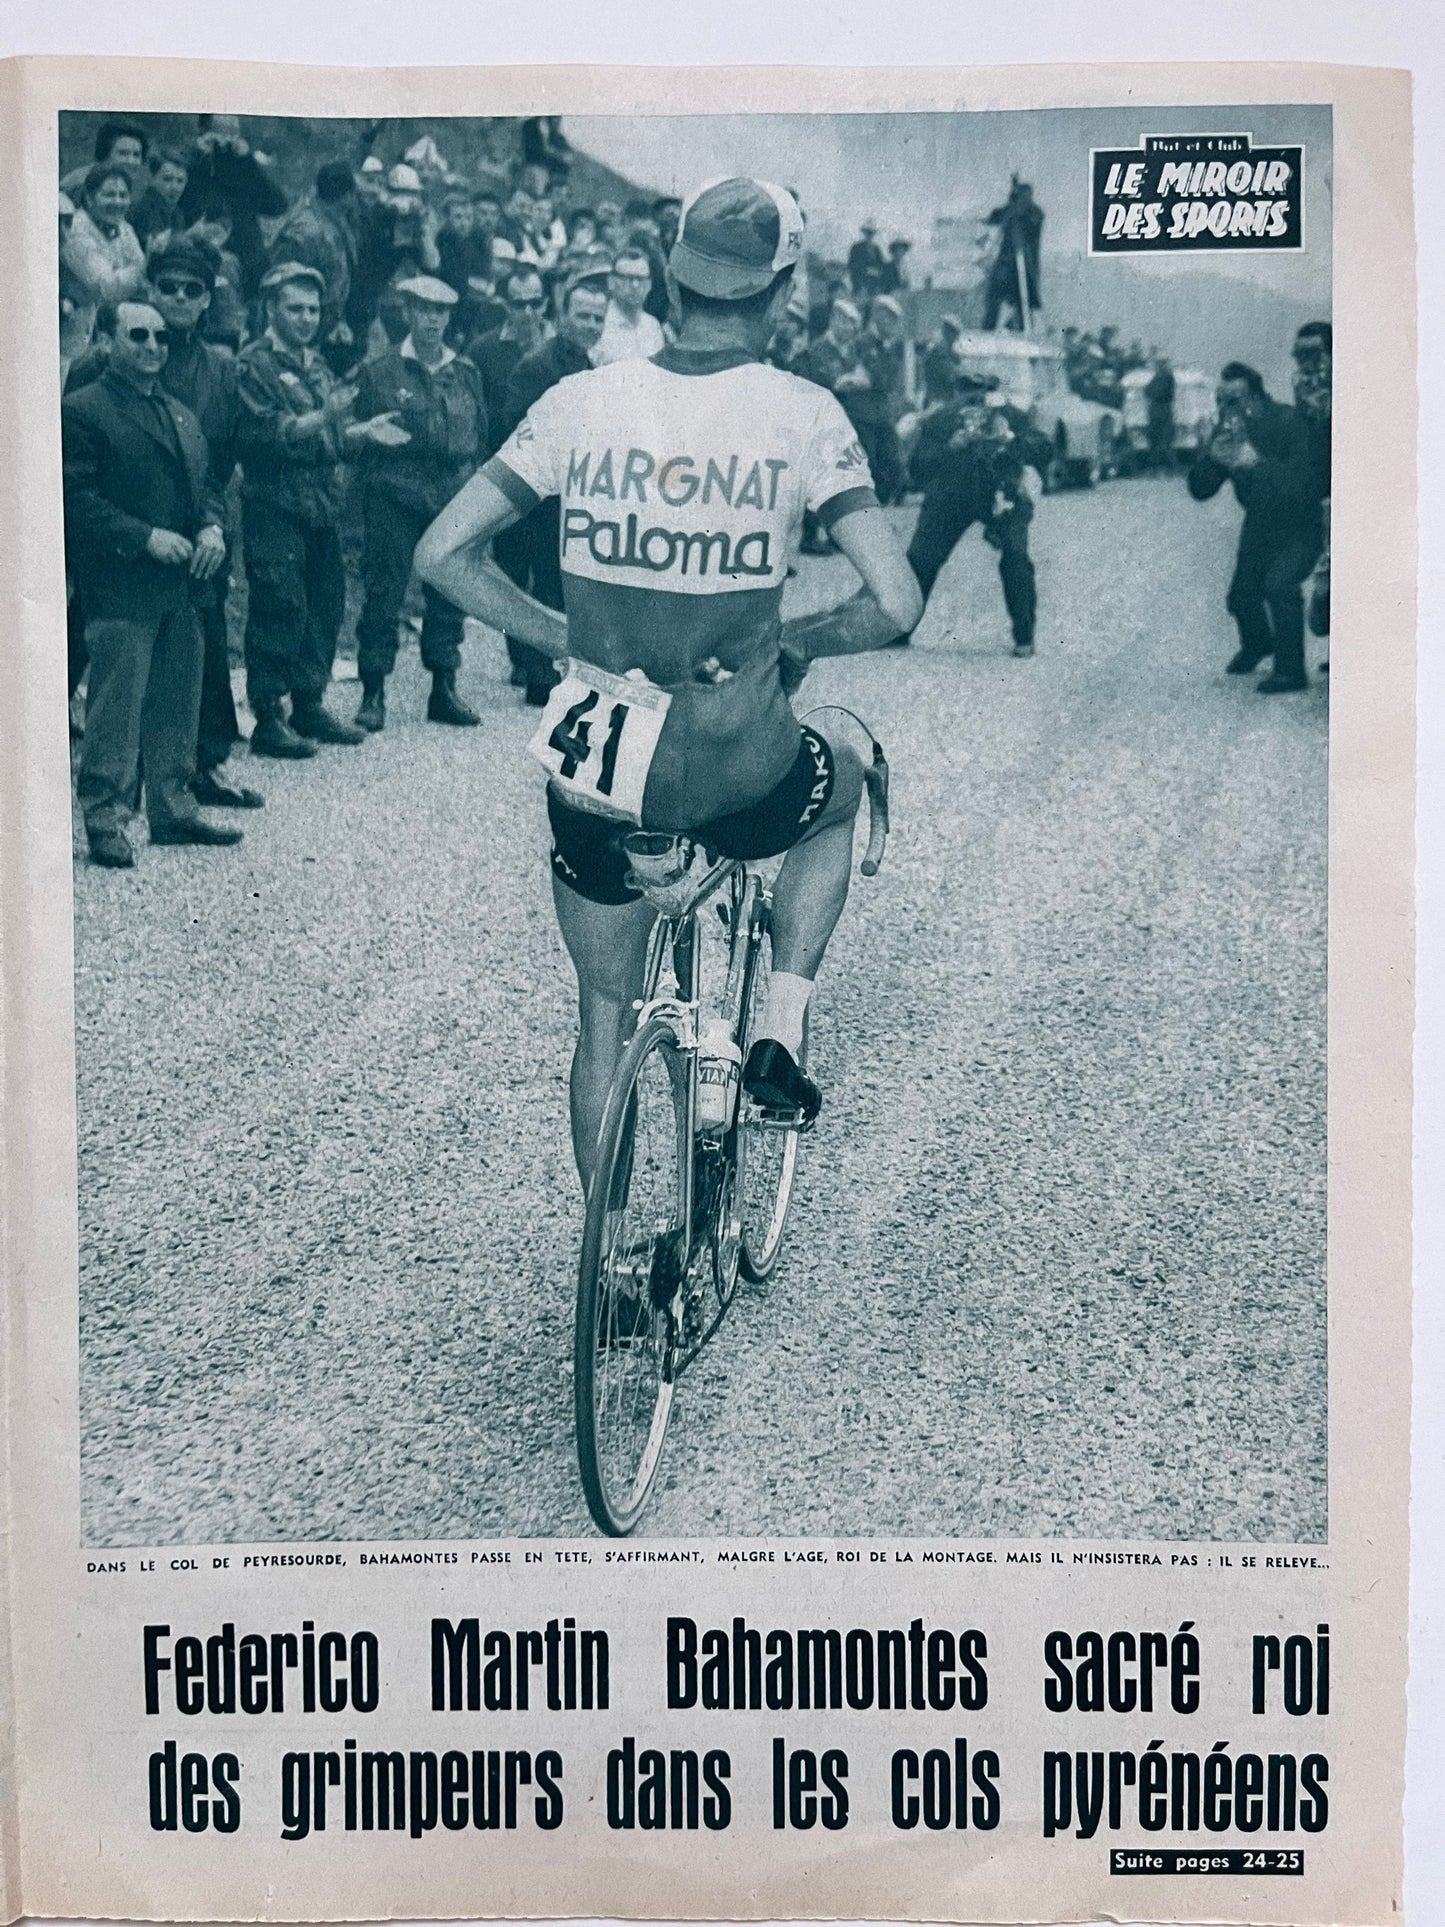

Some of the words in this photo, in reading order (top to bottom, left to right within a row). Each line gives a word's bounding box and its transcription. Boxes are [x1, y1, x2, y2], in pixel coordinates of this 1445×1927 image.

[1104, 163, 1147, 198] LE
[1156, 161, 1293, 198] MIROIR
[1101, 202, 1164, 240] DES
[1166, 200, 1290, 238] SPORTS
[565, 448, 788, 512] MARGNAT
[562, 508, 773, 576] Paloma
[548, 690, 629, 796] 41
[86, 1561, 127, 1574] DANS
[140, 1560, 156, 1572] LE
[170, 1559, 199, 1571] COL
[212, 1558, 230, 1569] DE
[243, 1555, 347, 1568] PEYRESOURDE,
[359, 1553, 458, 1566] BAHAMONTES
[471, 1552, 512, 1564] PASSE
[524, 1552, 543, 1564] EN
[555, 1552, 593, 1565] TETE,
[605, 1551, 705, 1565] S'AFFIRMANT,
[717, 1551, 775, 1563] MALGRE
[784, 1551, 828, 1564] L'AGE,
[836, 1551, 861, 1563] ROI
[869, 1551, 887, 1563] DE
[895, 1551, 914, 1563] LA
[922, 1552, 998, 1564] MONTAGE.
[1005, 1552, 1042, 1564] MAIS
[1051, 1553, 1064, 1564] IL
[1072, 1553, 1163, 1566] N'INSISTERA
[1170, 1555, 1198, 1567] PAS
[1219, 1556, 1233, 1567] IL
[1241, 1556, 1257, 1568] SE
[1265, 1556, 1330, 1569] RELEVE...
[144, 1621, 380, 1715] Federico
[431, 1618, 610, 1711] Martin
[667, 1617, 988, 1712] Bahamontes
[1044, 1621, 1200, 1714] sacré
[1252, 1623, 1330, 1716] roi
[149, 1740, 241, 1833] des
[281, 1739, 563, 1841] grimpeurs
[606, 1737, 732, 1832] dans
[773, 1738, 849, 1831] les
[891, 1738, 1001, 1831] cols
[1044, 1740, 1330, 1839] pyrénéens
[1115, 1852, 1164, 1869] Suite
[1175, 1857, 1230, 1872] pages
[1242, 1852, 1300, 1869] 24-25
